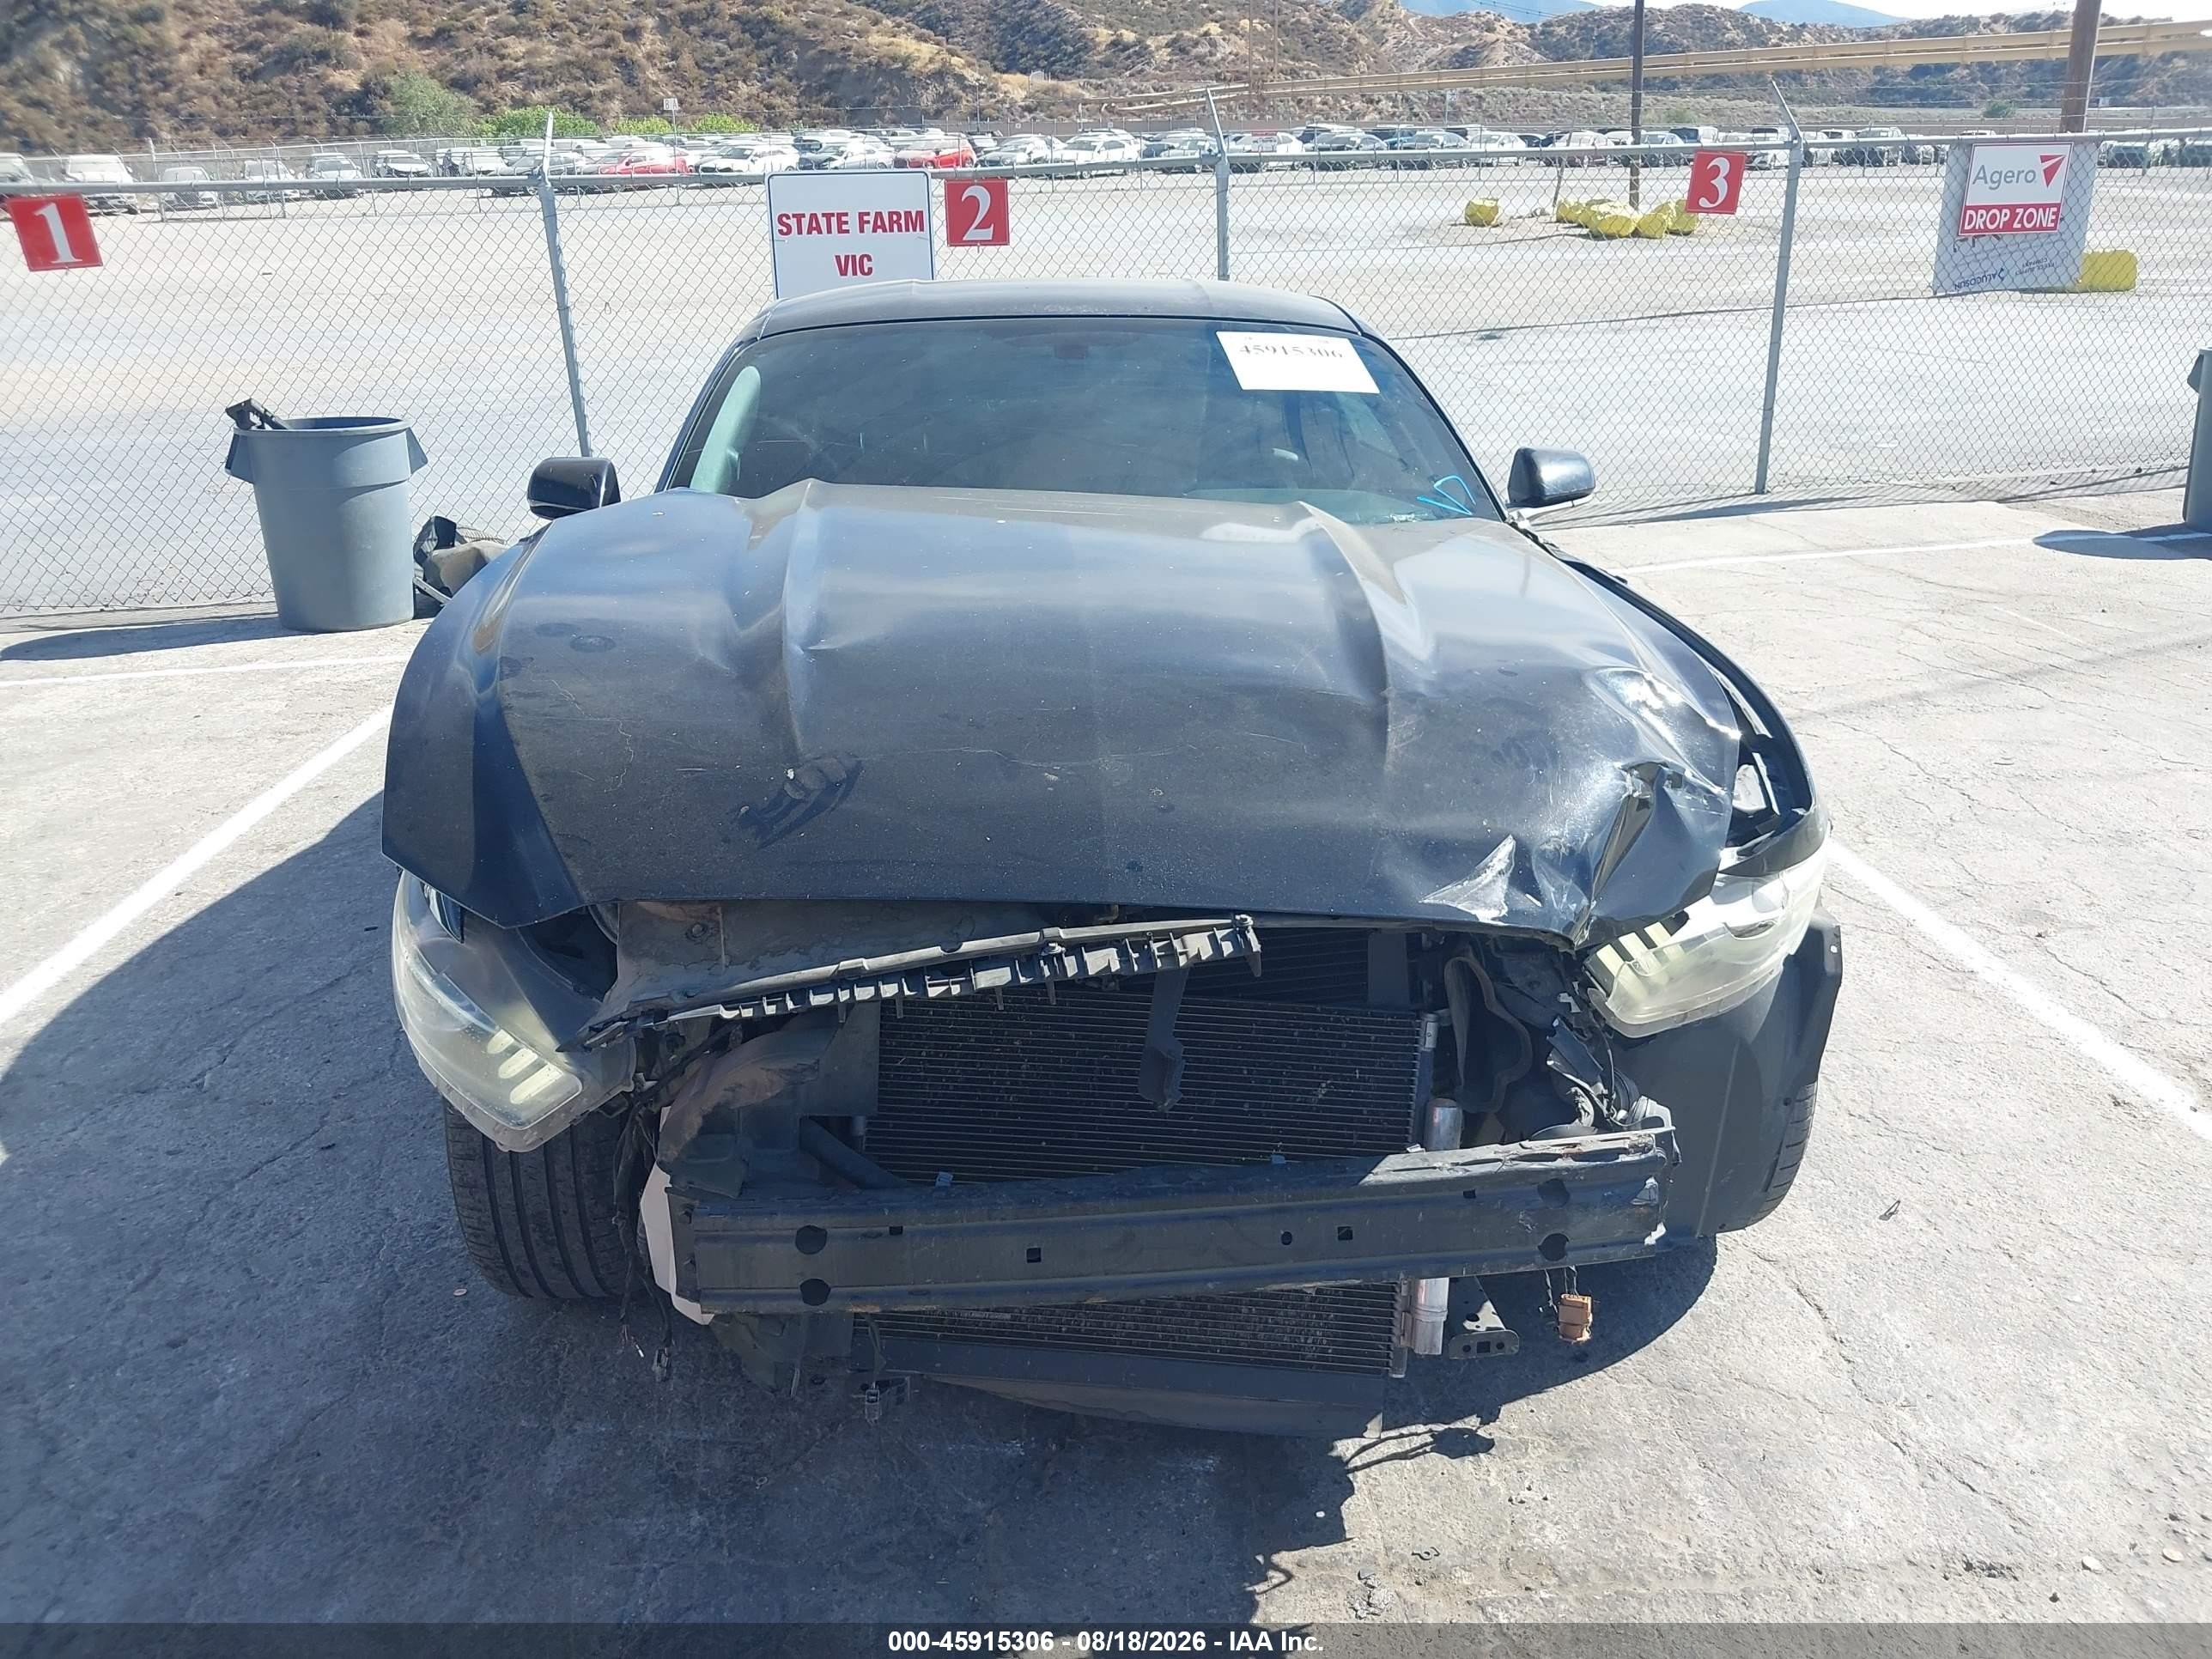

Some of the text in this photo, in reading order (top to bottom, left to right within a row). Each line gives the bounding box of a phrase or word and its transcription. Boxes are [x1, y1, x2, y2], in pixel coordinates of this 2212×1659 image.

[1698, 156, 1730, 209] 3
[1972, 164, 2037, 190] Agero
[776, 210, 926, 236] STATE FARM
[960, 185, 994, 241] 2
[1963, 206, 2058, 230] DROP ZONE
[33, 202, 83, 264] 1
[835, 253, 873, 276] VIC
